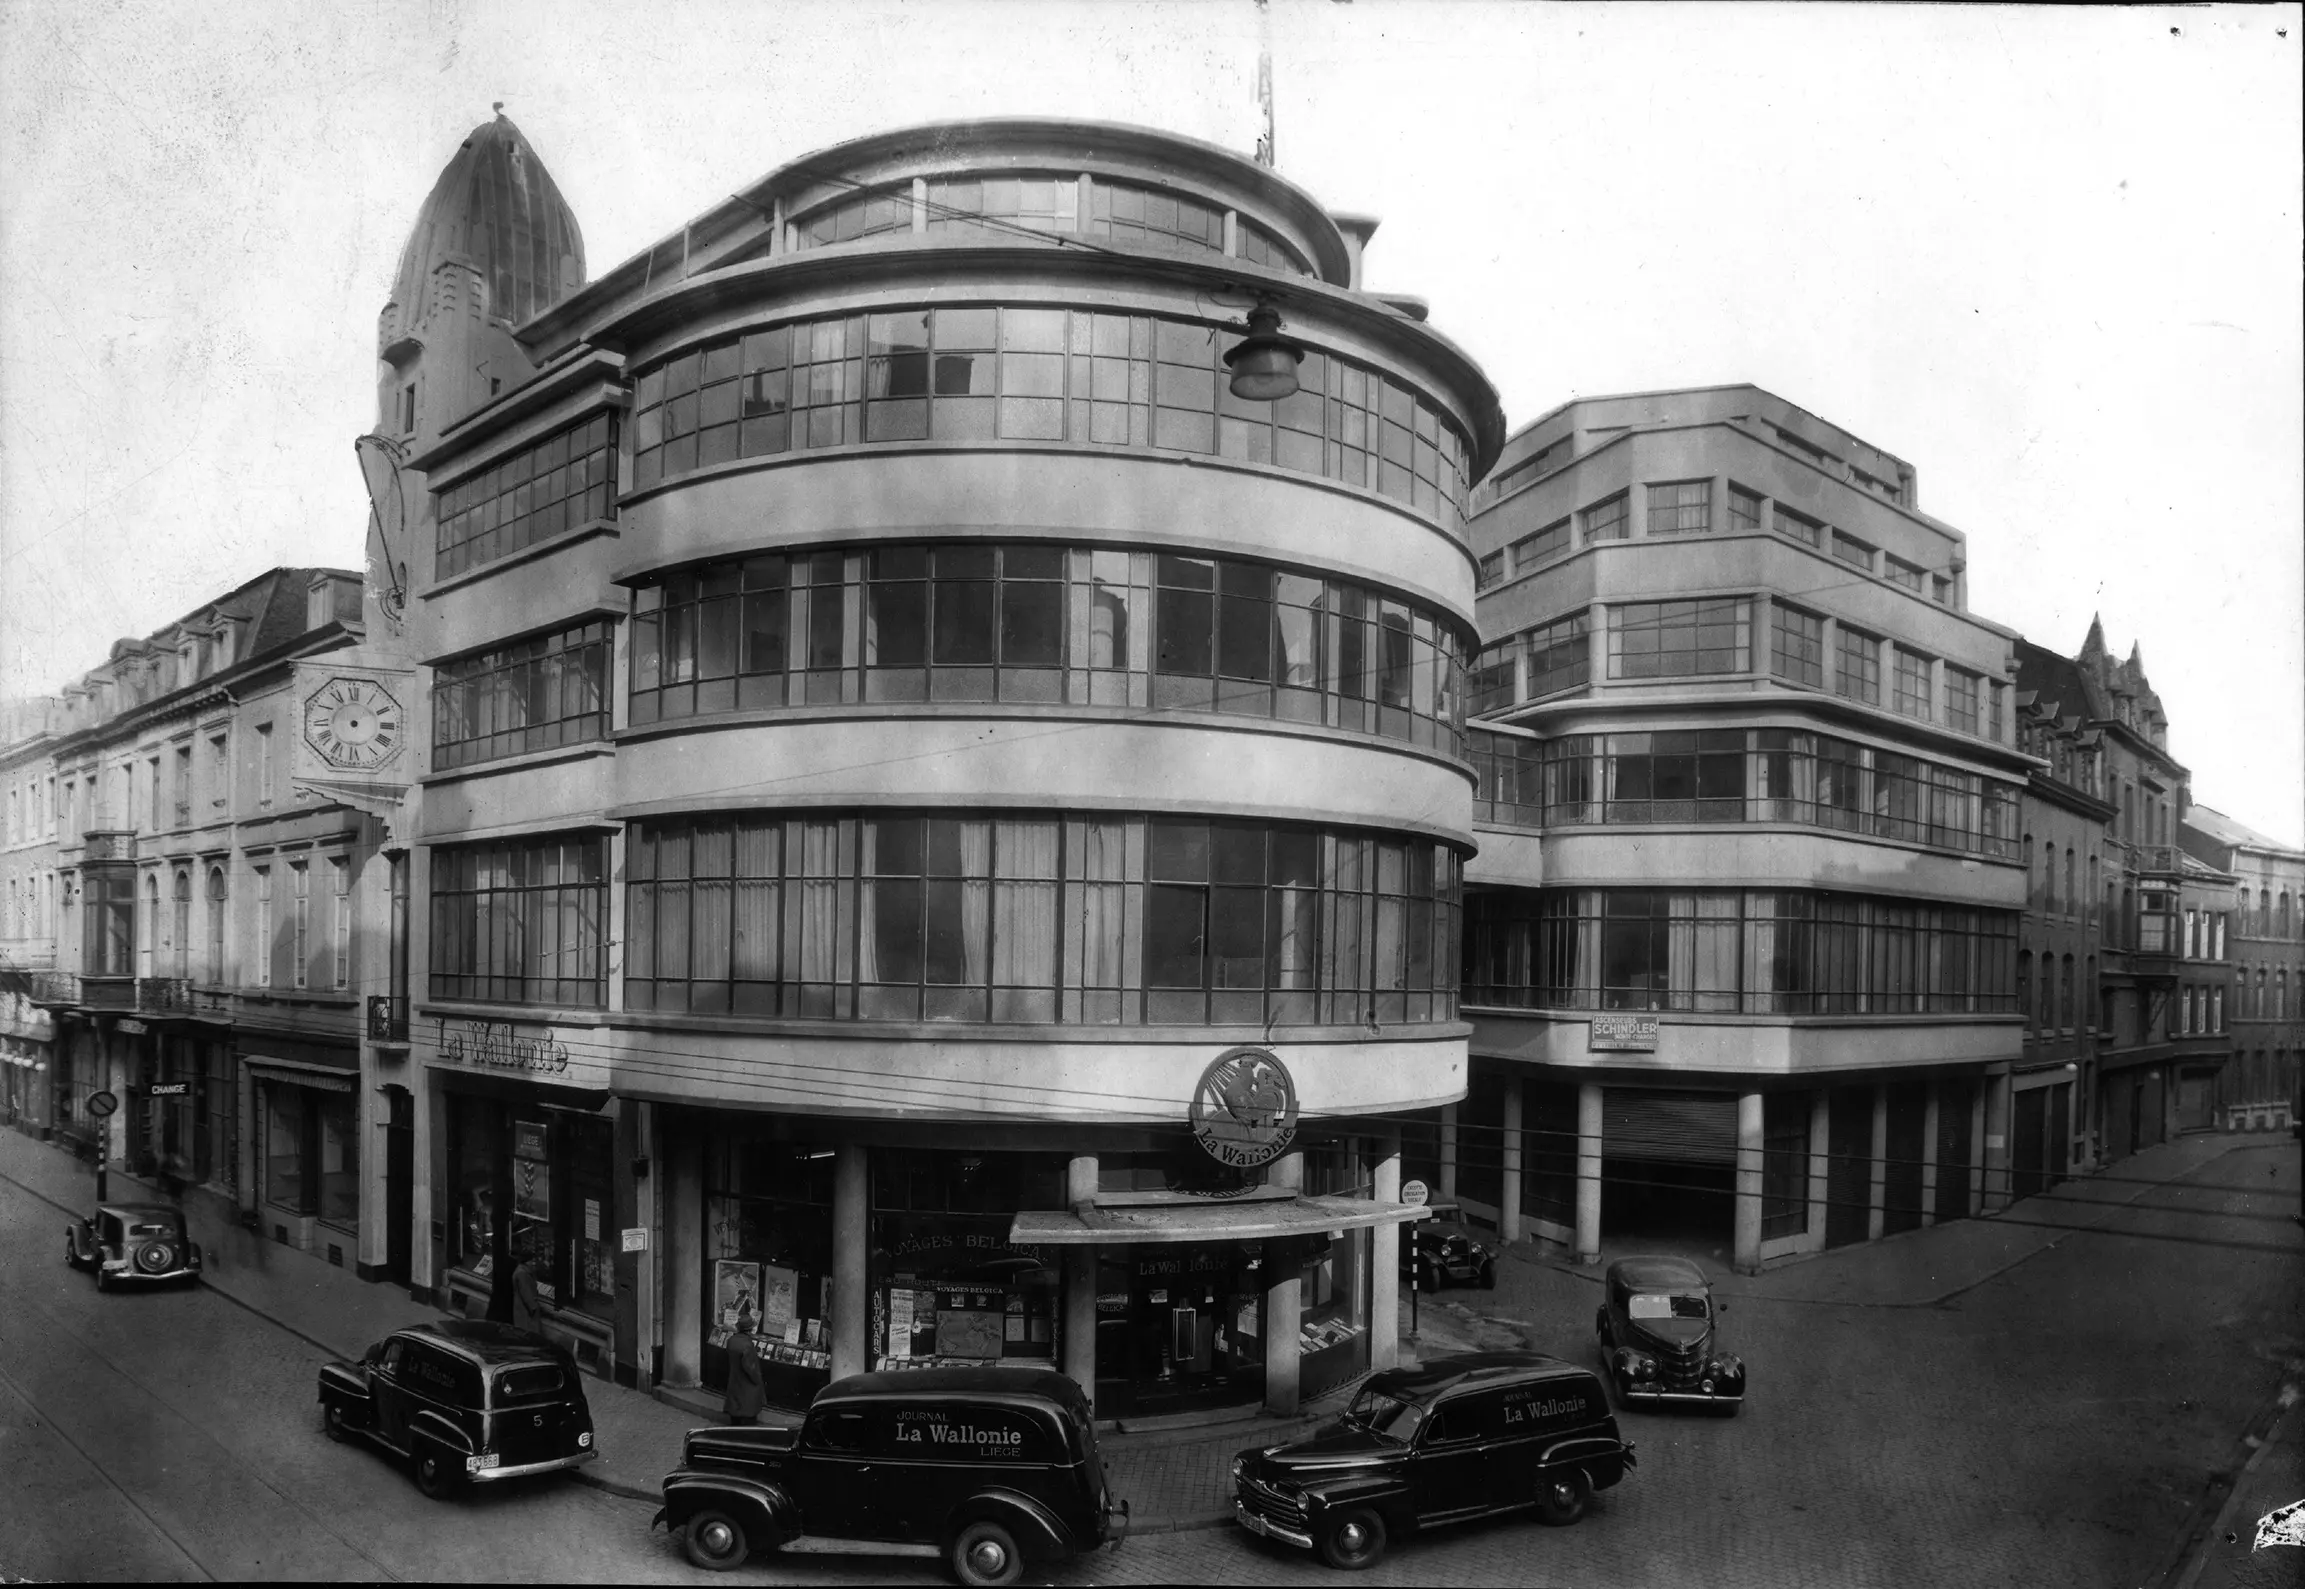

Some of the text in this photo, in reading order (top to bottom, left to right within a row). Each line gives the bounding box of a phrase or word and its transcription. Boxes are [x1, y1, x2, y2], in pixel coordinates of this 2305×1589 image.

[1594, 1023, 1657, 1034] SCHINDLER
[432, 1017, 568, 1075] La Wallonie
[151, 1084, 186, 1095] CHANGE
[1199, 1128, 1293, 1165] La Wallonie
[884, 1234, 953, 1258] VOYAGES
[937, 1286, 1004, 1295] VOYAGES BELGICA
[896, 1411, 950, 1422] JOURNAL
[1503, 1406, 1524, 1424] La
[1527, 1395, 1586, 1419] Wallonie
[533, 1415, 544, 1427] 5
[895, 1422, 1022, 1445] La Wallonie
